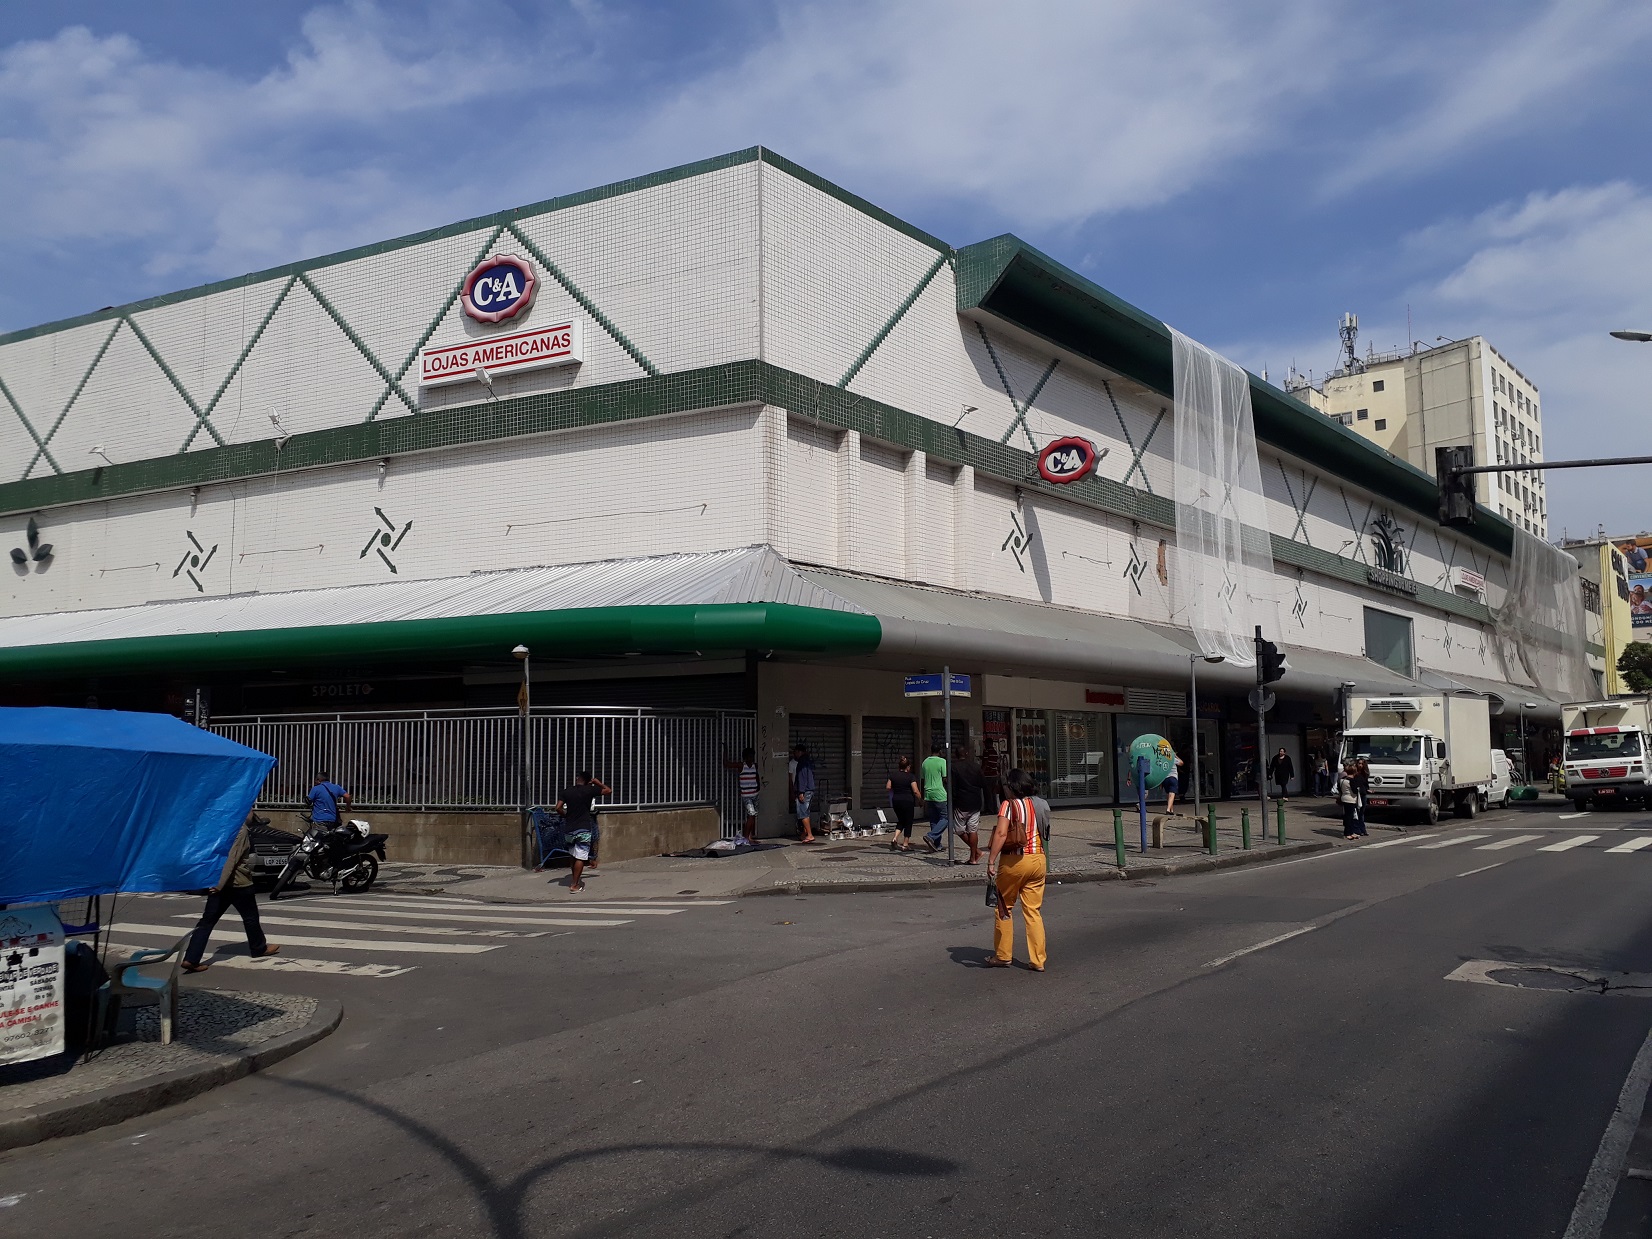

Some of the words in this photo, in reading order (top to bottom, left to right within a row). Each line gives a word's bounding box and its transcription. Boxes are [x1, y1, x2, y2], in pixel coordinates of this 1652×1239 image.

[473, 272, 520, 306] C&A
[423, 352, 469, 373] LOJAS
[472, 332, 571, 365] AMERICANAS
[1046, 449, 1083, 472] C&A
[312, 683, 374, 697] SPOLETO
